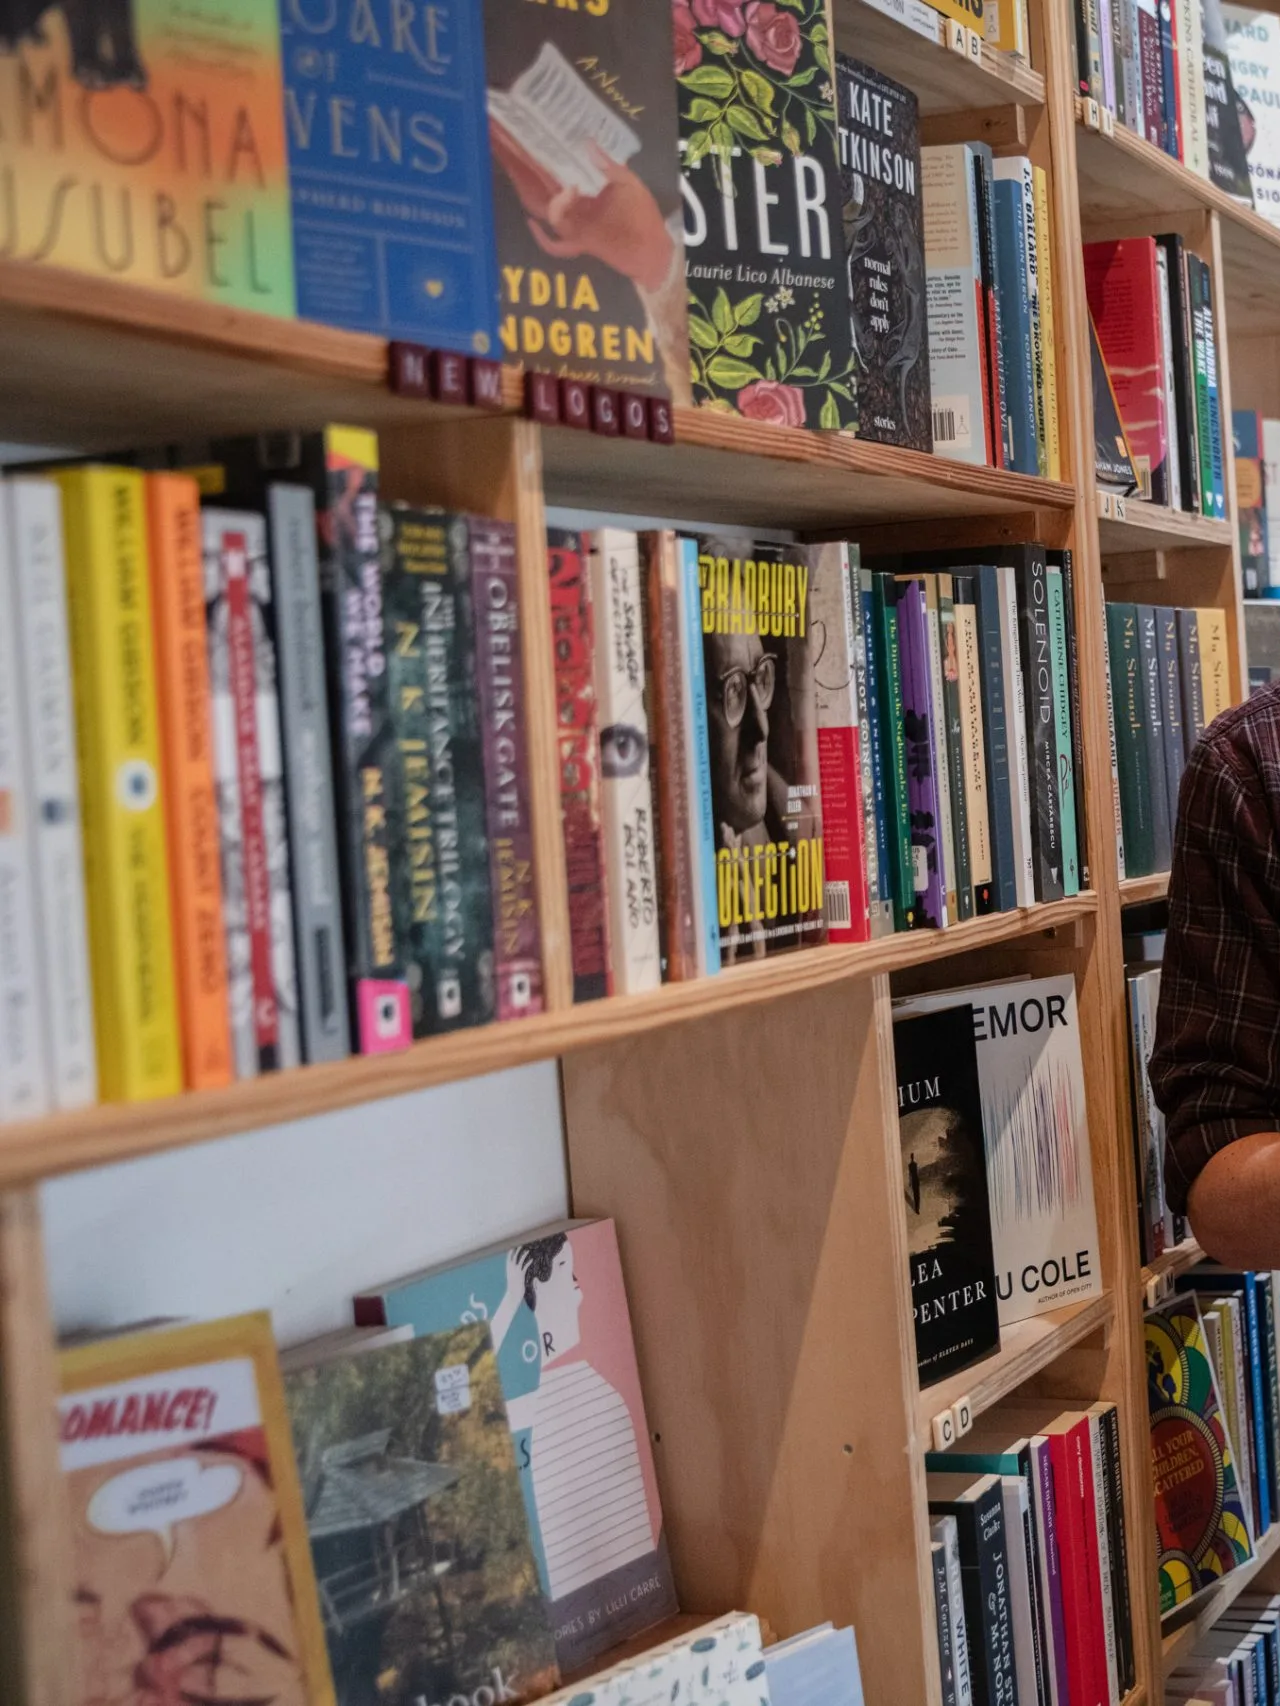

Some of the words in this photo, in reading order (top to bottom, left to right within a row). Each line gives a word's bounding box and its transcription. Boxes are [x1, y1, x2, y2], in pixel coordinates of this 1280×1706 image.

[956, 28, 964, 48] A
[971, 37, 979, 56] B
[849, 81, 894, 138] KATE
[838, 127, 916, 197] TKINSON
[503, 265, 599, 312] YDIA
[684, 260, 733, 281] Laurie
[736, 264, 768, 284] Lico
[771, 268, 836, 290] Albanese
[863, 256, 892, 277] normal
[869, 274, 889, 293] rules
[1024, 203, 1036, 275] BALLARD
[1032, 318, 1043, 389] DROWNED
[869, 313, 891, 335] apply
[1194, 309, 1203, 337] THE
[1202, 305, 1217, 389] ALEXANDRIA
[404, 351, 501, 401] NEW
[535, 379, 671, 434] LOGOS
[873, 415, 897, 432] stories
[1208, 395, 1221, 480] KINGSNORTH
[1112, 464, 1132, 476] JONES
[702, 555, 808, 639] BRADBURY
[1053, 589, 1066, 670] CATHERINE
[1123, 616, 1134, 649] My
[1143, 616, 1154, 650] My
[1164, 620, 1175, 652] My
[487, 578, 516, 733] OBELISK
[1031, 561, 1051, 725] SOLENOID
[1043, 741, 1053, 782] MIRCEA
[857, 670, 868, 712] NOT
[894, 697, 902, 718] the
[1056, 673, 1069, 739] CHIDGEY
[1125, 657, 1141, 740] Struggle
[1147, 656, 1163, 739] Struggle
[1166, 660, 1181, 739] Struggle
[860, 719, 872, 779] GOING
[894, 720, 908, 800] Nightingale's
[494, 740, 519, 828] GATE
[398, 739, 436, 920] JEMISIN
[863, 784, 878, 894] ANYWHERE
[972, 993, 1069, 1043] EMOR
[1021, 1248, 1091, 1293] COLE
[1038, 1292, 1058, 1305] AUTHOR
[1066, 1286, 1080, 1297] OPEN
[1080, 1282, 1093, 1294] CITY
[522, 1331, 557, 1363] OR
[60, 1384, 218, 1443] OMANCE!
[943, 1420, 952, 1442] C
[960, 1406, 969, 1429] D
[979, 1501, 1001, 1527] Susanna
[983, 1519, 1001, 1542] Clarke
[587, 1608, 602, 1624] BY
[604, 1595, 628, 1617] LILLI
[629, 1574, 662, 1606] CARRÉ
[936, 1566, 946, 1600] J.M.
[939, 1602, 952, 1657] Coetzee
[992, 1551, 1012, 1670] JONATHAN
[955, 1617, 970, 1697] WHITE
[989, 1622, 999, 1651] Mr
